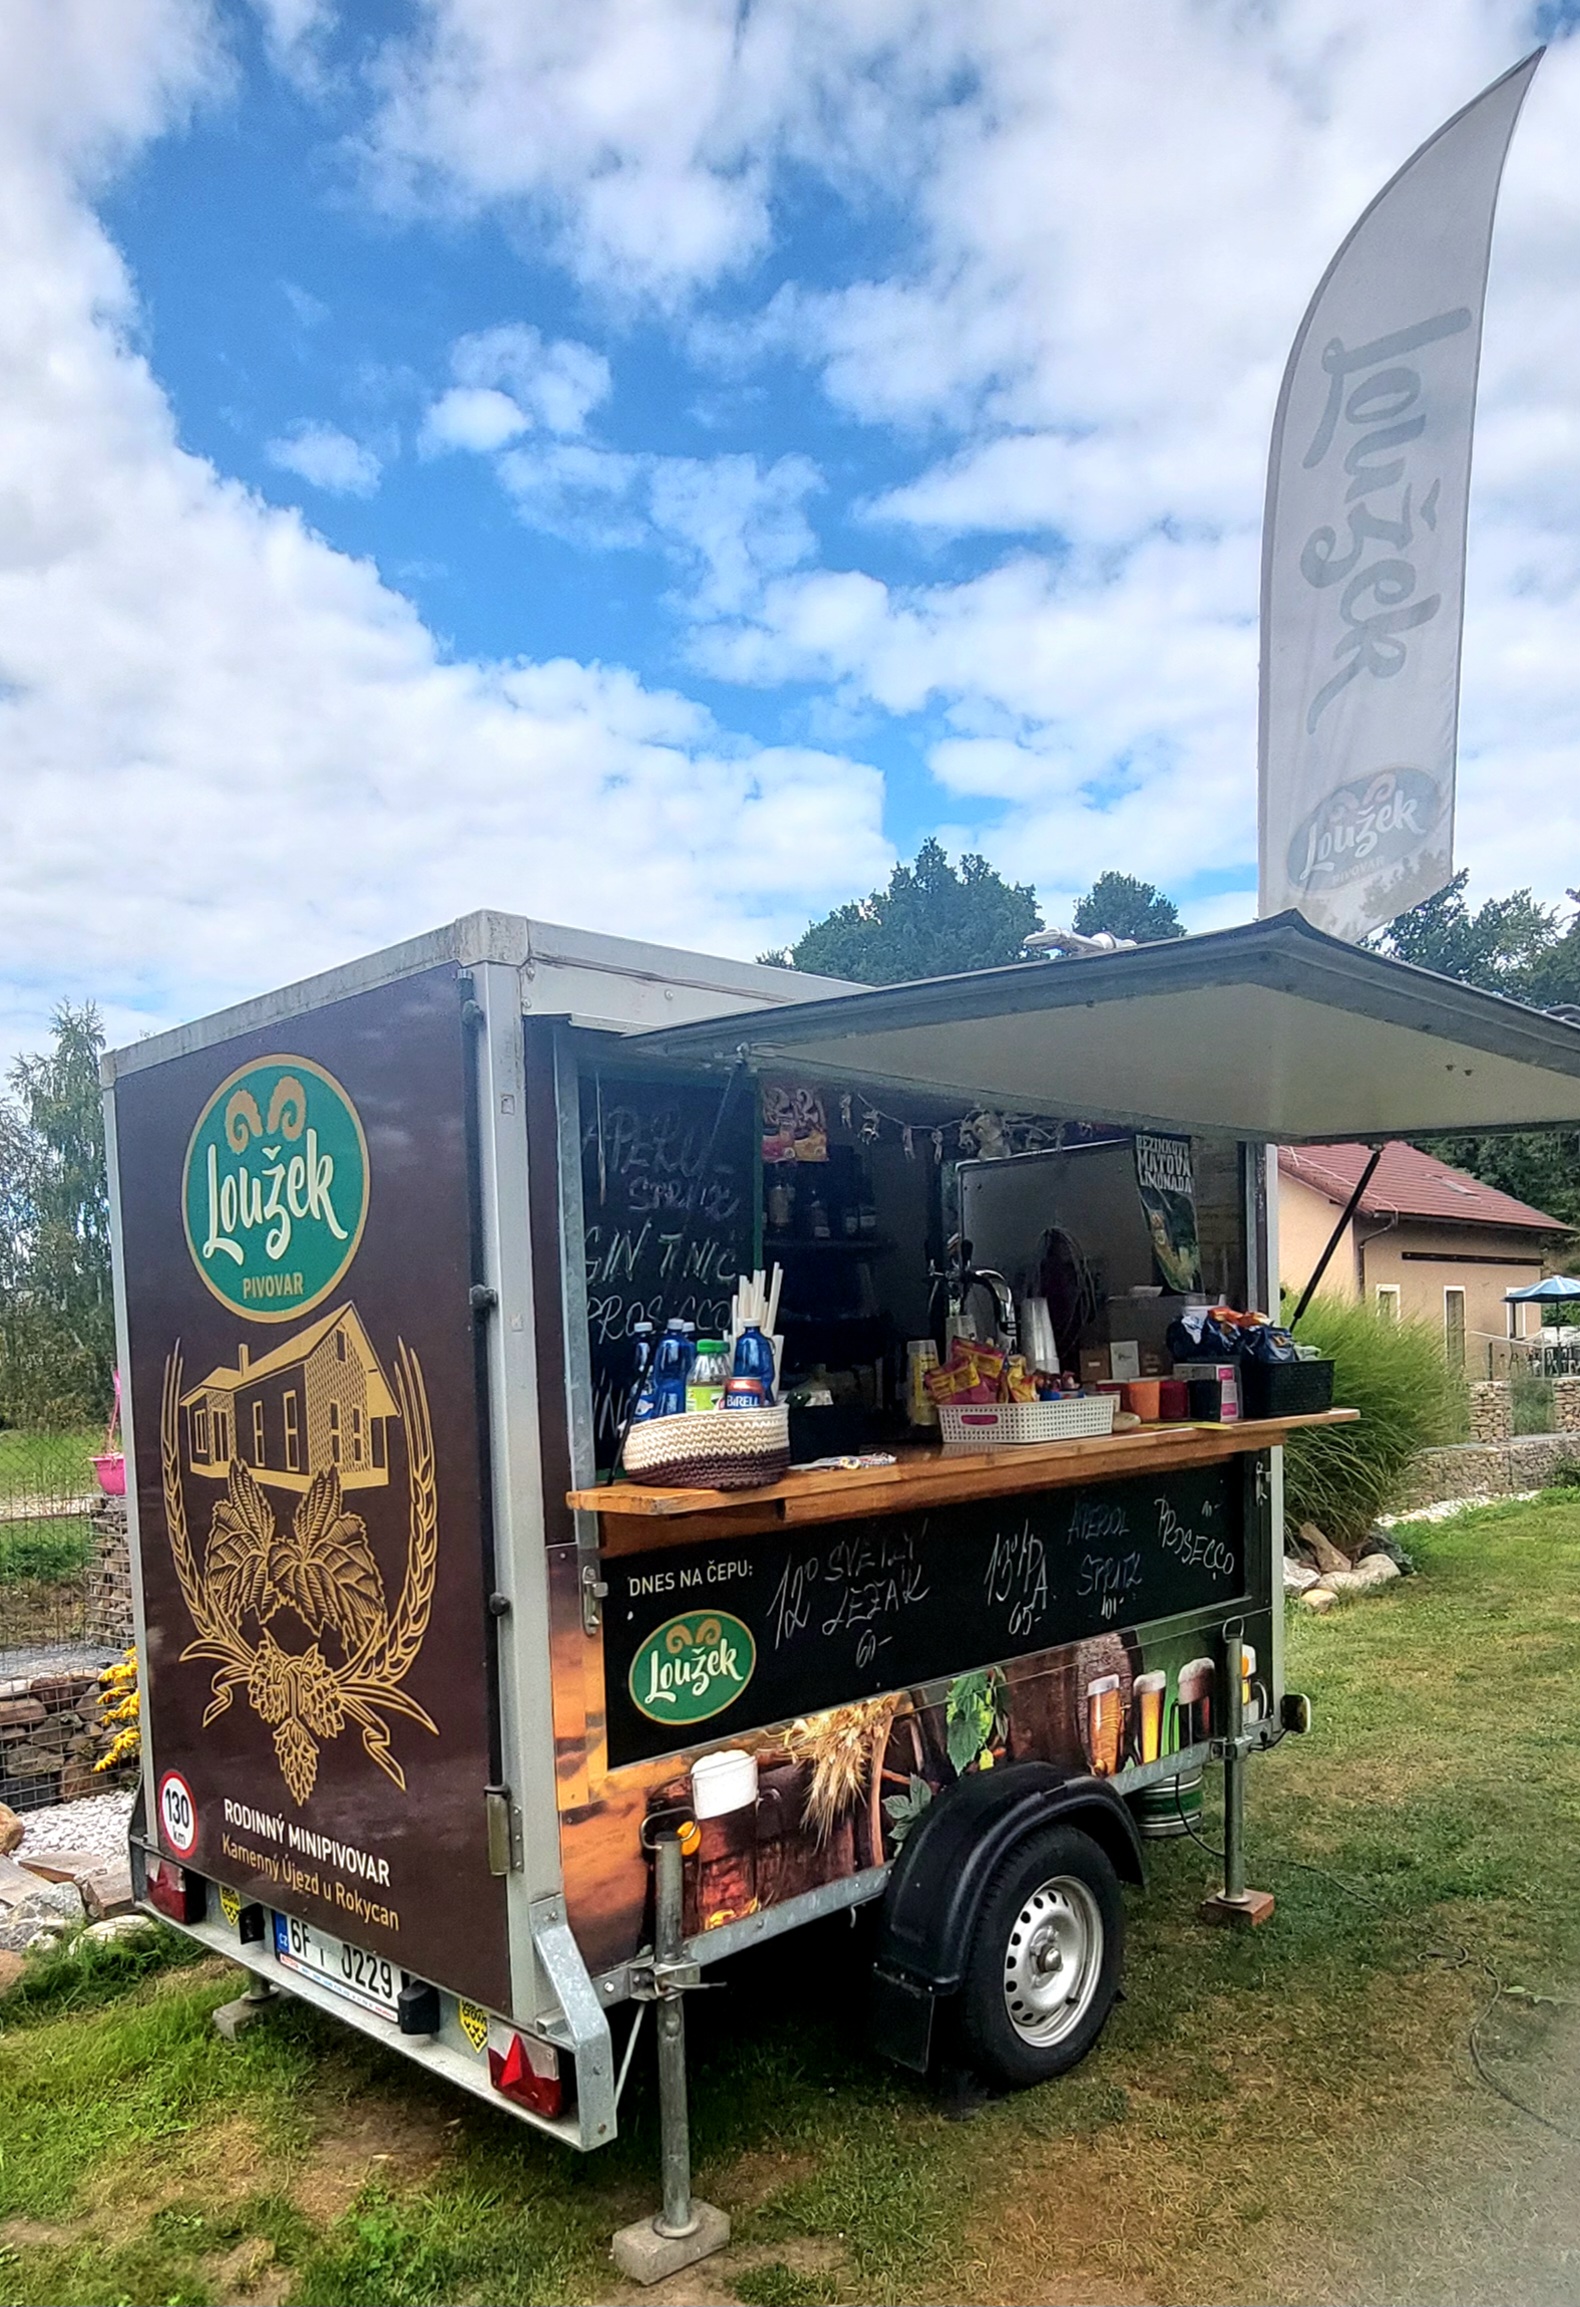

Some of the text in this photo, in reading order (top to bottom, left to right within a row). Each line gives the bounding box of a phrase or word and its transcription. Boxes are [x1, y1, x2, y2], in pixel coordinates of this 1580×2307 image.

[1301, 307, 1472, 736] Loužek
[1300, 789, 1427, 881] Loužek
[202, 1127, 349, 1266] Loužek
[242, 1271, 304, 1300] PIVOVAR
[1154, 1494, 1234, 1575] PROSECCO
[629, 1559, 753, 1597] DNES NA ČEPU:
[644, 1638, 744, 1704] Loužek
[165, 1787, 190, 1829] 130
[173, 1825, 187, 1846] km
[224, 1798, 391, 1887] RODINNÝ MINIPIVOVAR
[222, 1833, 280, 1882] Kamenný
[281, 1850, 320, 1896] Újezd
[322, 1883, 332, 1901] u
[335, 1881, 400, 1931] Rokycan
